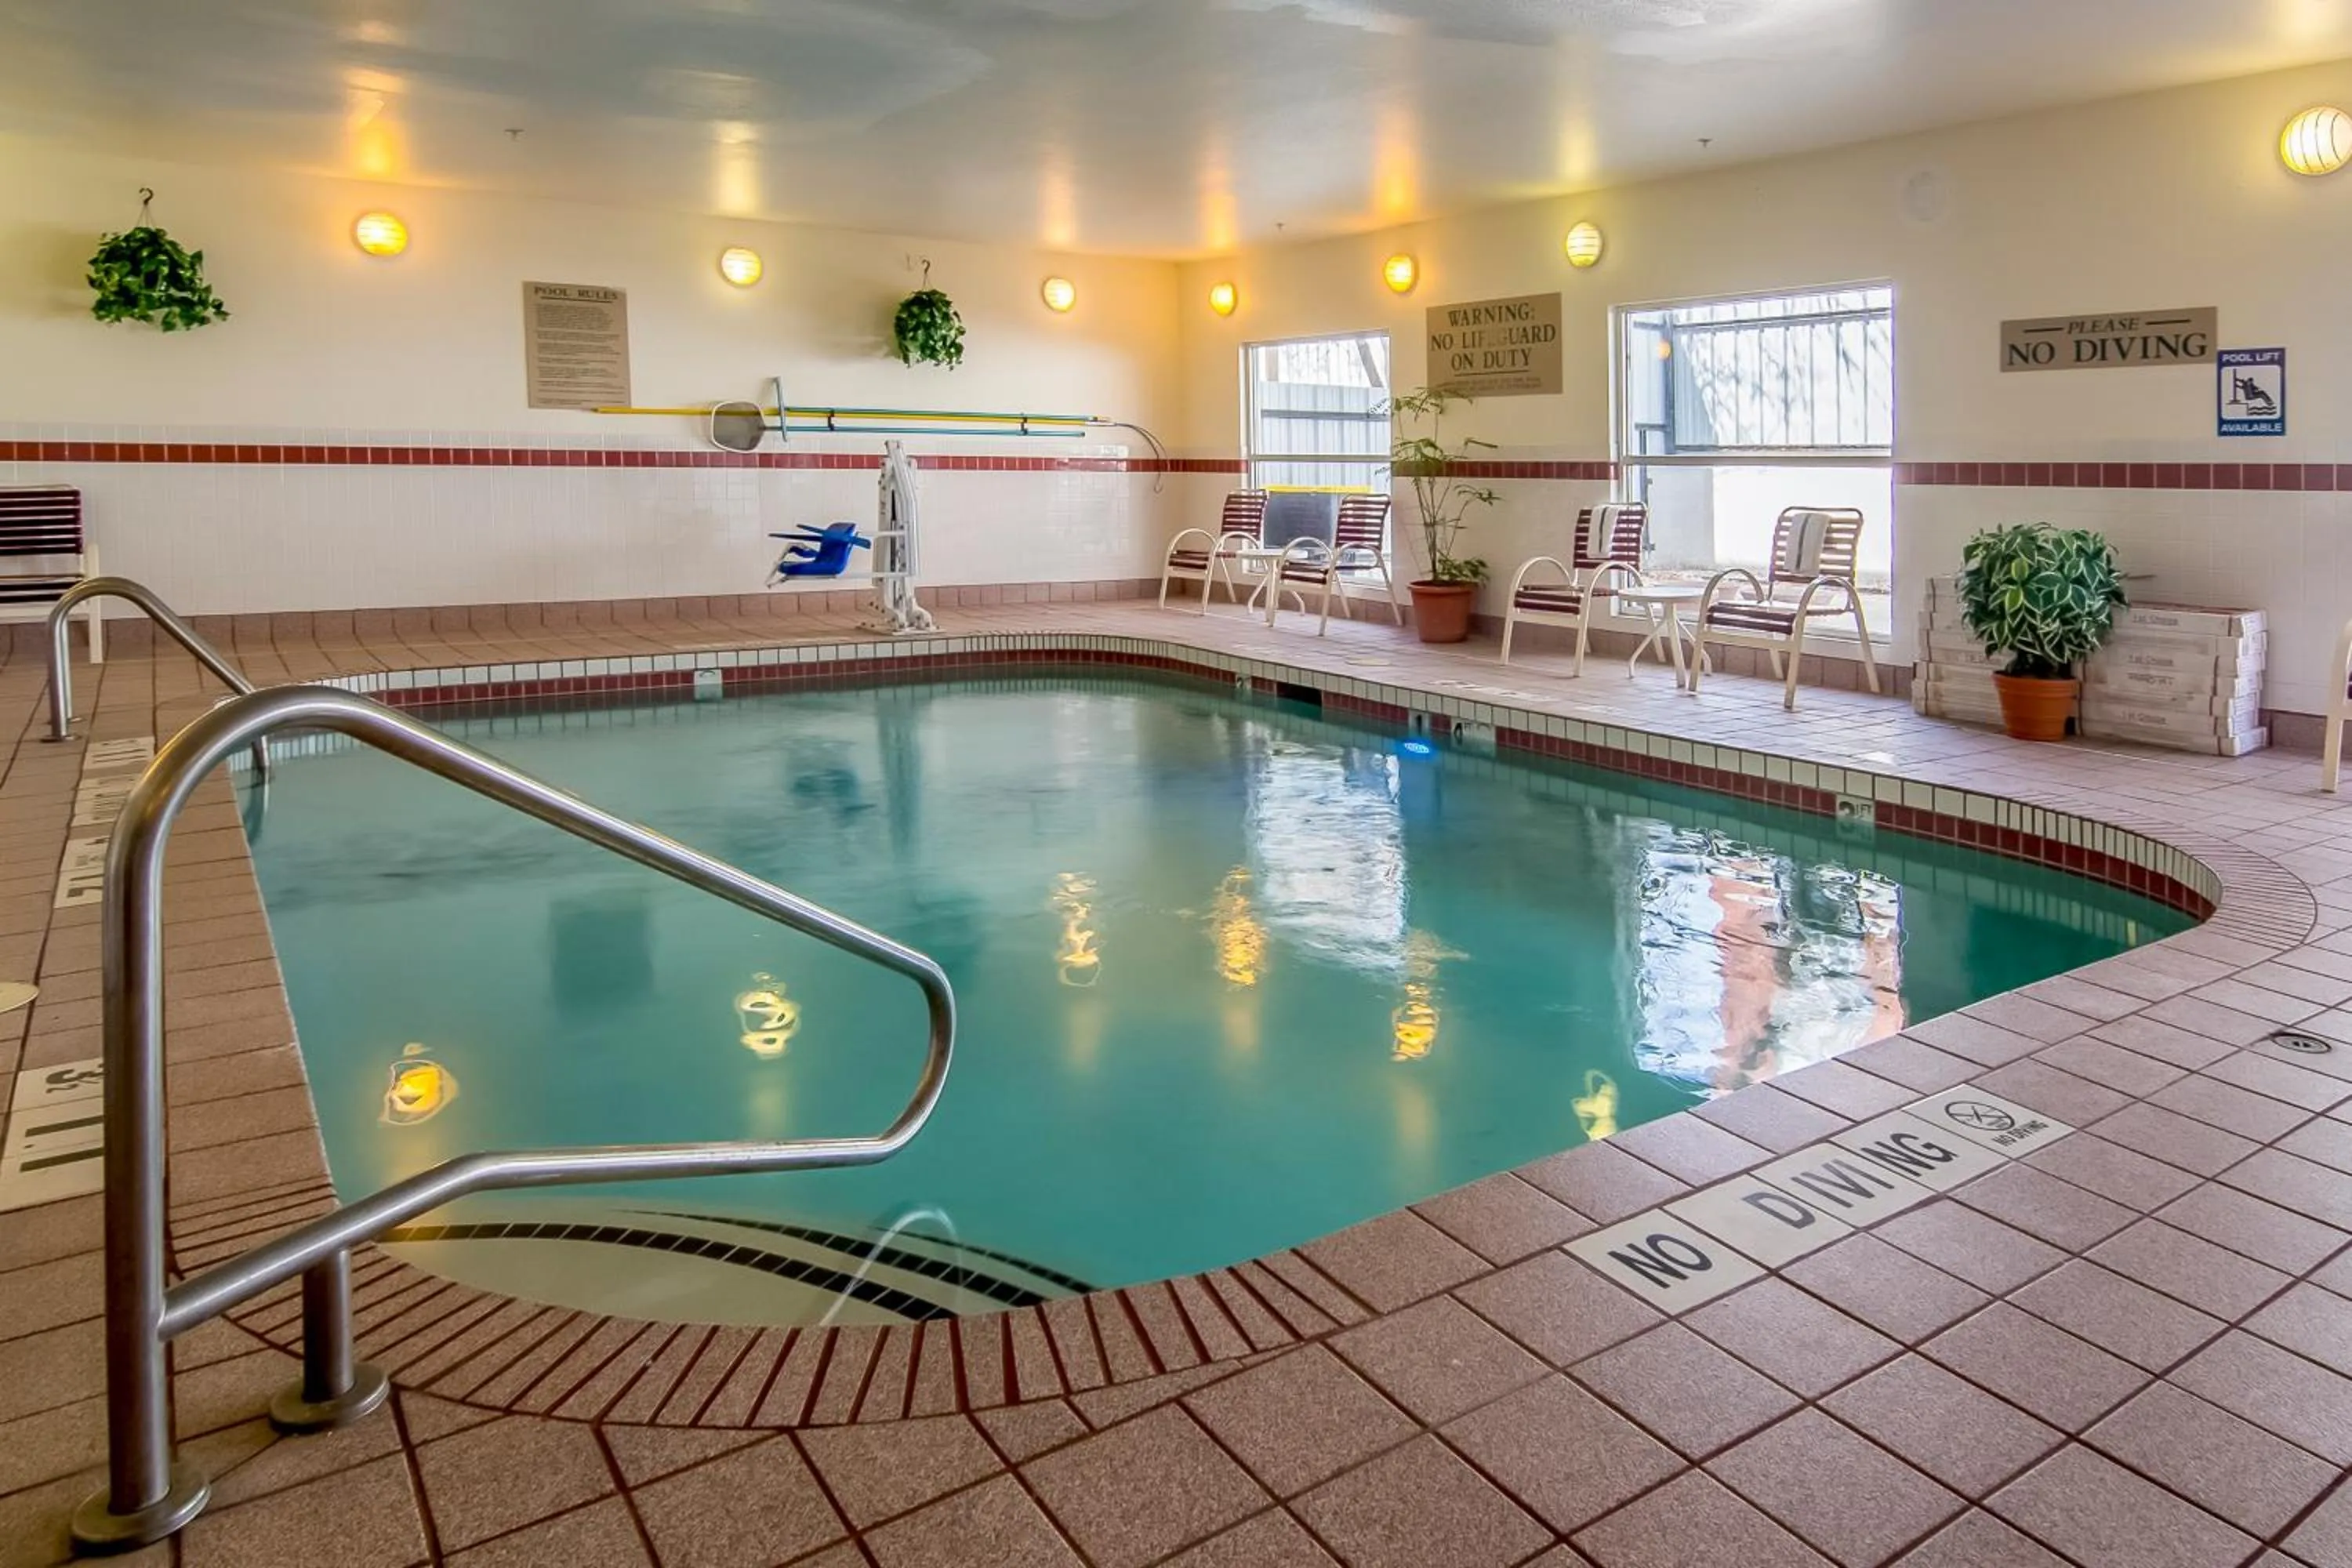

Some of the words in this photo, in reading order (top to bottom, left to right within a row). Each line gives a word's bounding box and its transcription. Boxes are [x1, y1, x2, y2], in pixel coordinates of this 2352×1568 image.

[534, 285, 569, 297] POOL
[1447, 303, 1536, 327] WARNING:
[2067, 317, 2140, 335] PLEASE
[1431, 332, 1454, 351] NO
[1462, 323, 1556, 350] LIFGUARD
[2007, 340, 2056, 366] NO
[2074, 332, 2208, 364] DIVING
[1451, 353, 1475, 372] ON
[1483, 347, 1532, 369] DUTY
[2222, 353, 2254, 362] POOL
[2256, 351, 2280, 361] LIFT
[2220, 423, 2283, 433] AVAILABLE
[1607, 1232, 1713, 1290] NO
[1741, 1132, 1958, 1229] DIVING
